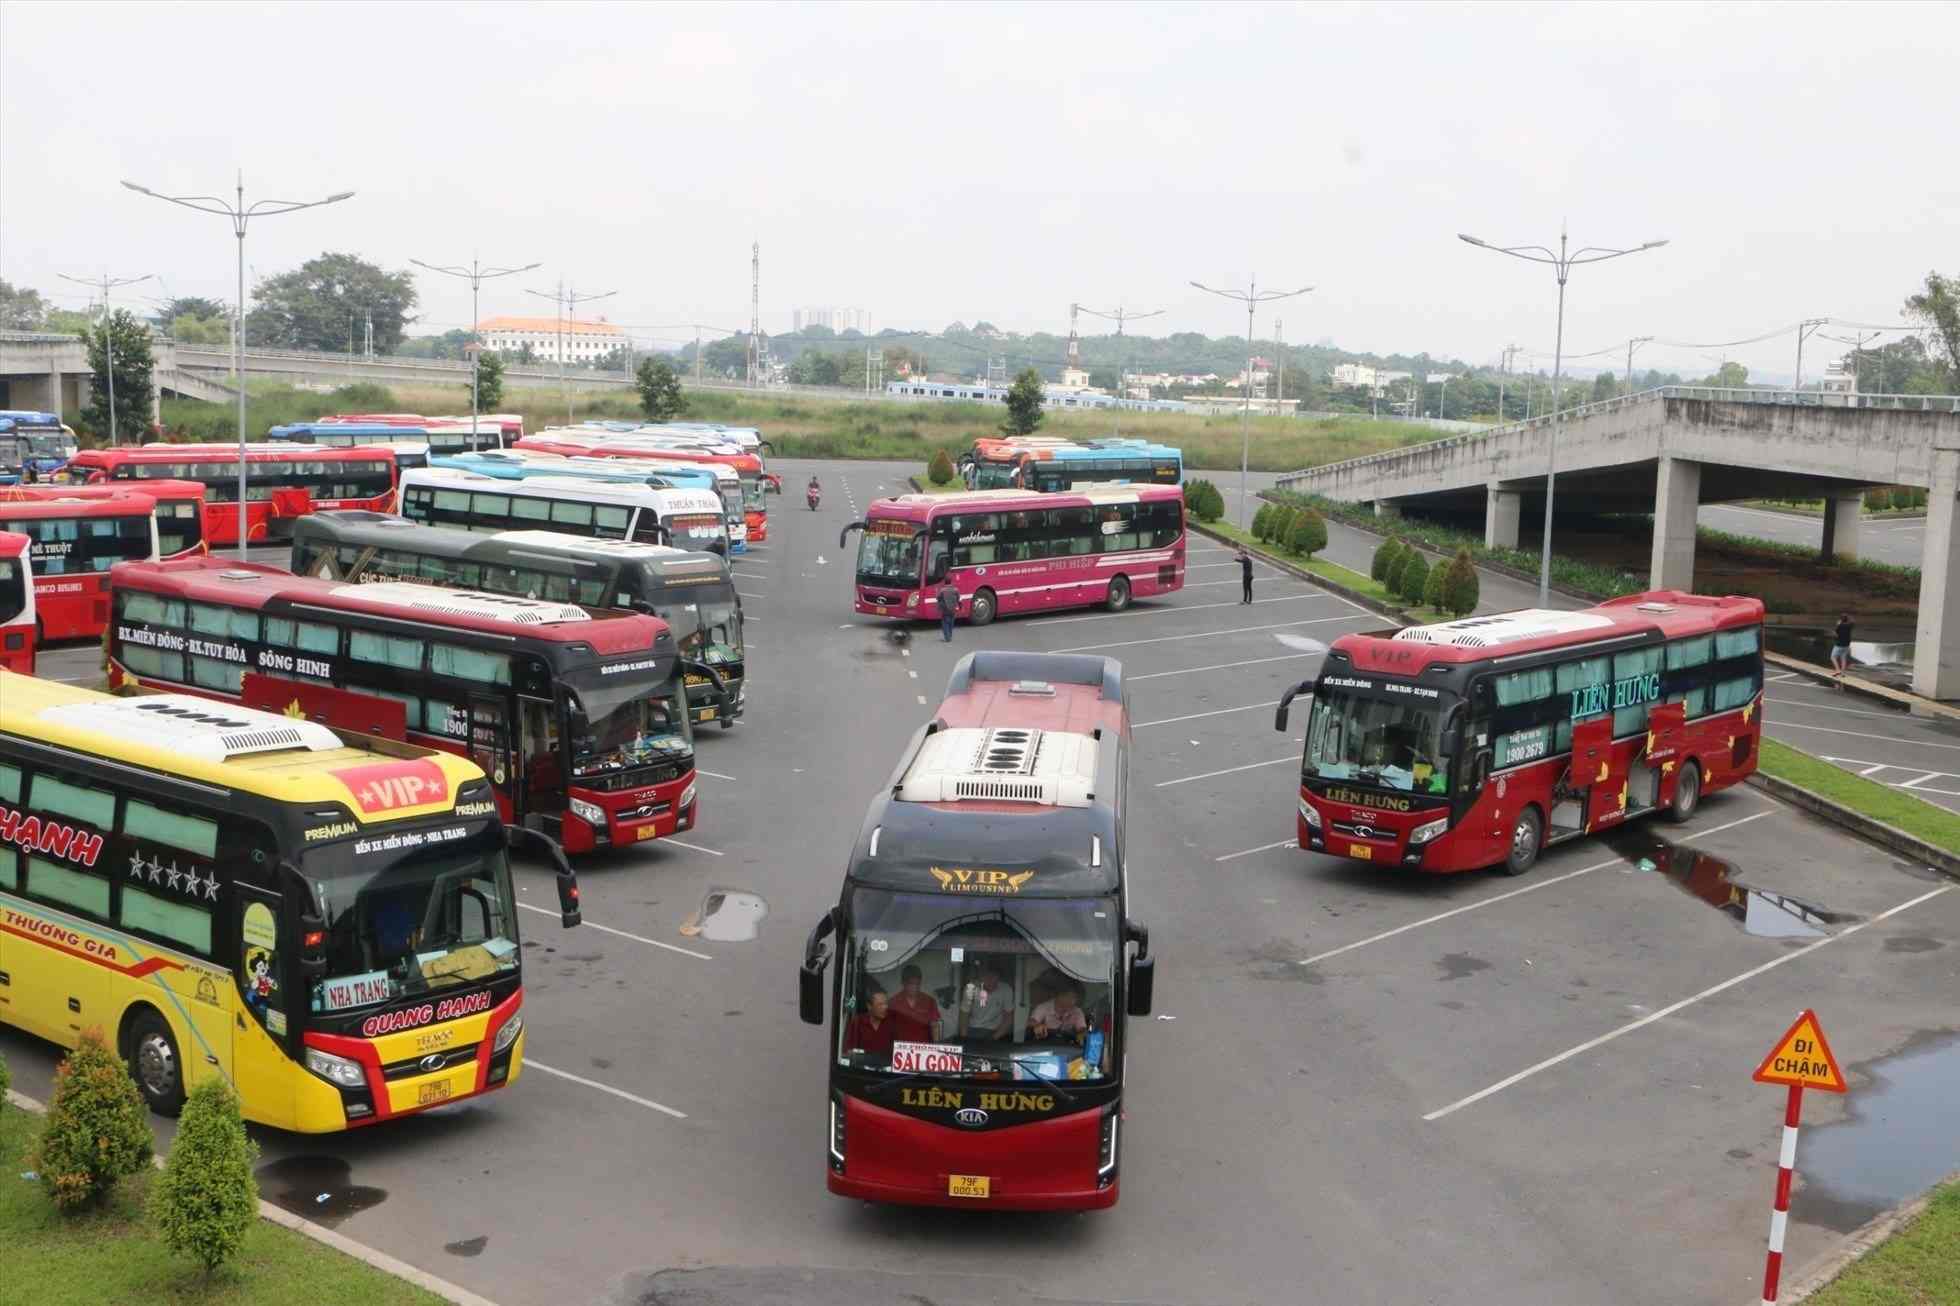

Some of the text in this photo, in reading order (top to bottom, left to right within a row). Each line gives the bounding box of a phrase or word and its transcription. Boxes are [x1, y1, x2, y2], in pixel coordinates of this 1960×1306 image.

[157, 631, 184, 651] ĐÔNG
[188, 638, 247, 663] BX.TUY HÒA
[258, 650, 331, 679] SÔNG HINH
[1371, 648, 1411, 661] VIP
[1571, 673, 1660, 719] LIÊN HƯNG
[444, 719, 468, 736] 1900
[370, 776, 424, 808] VIP
[456, 801, 496, 817] PREMIUM
[304, 822, 358, 841] PREMIUM
[355, 838, 371, 855] BẾN
[372, 839, 383, 852] XE
[427, 830, 442, 843] NHA
[443, 827, 467, 842] TRANG
[952, 870, 1009, 884] VIP
[950, 884, 1014, 893] LIMOUSINE
[5, 911, 117, 959] THƯƠNG GIA
[328, 975, 389, 1009] NHA TRANG
[363, 991, 492, 1037] QUANG HẠNH
[1794, 1039, 1813, 1054] ĐI
[893, 1049, 921, 1073] SÀI
[1774, 1057, 1828, 1078] CHẬM
[902, 1086, 1055, 1112] LIÊN HƯNG
[960, 1112, 983, 1123] KIA
